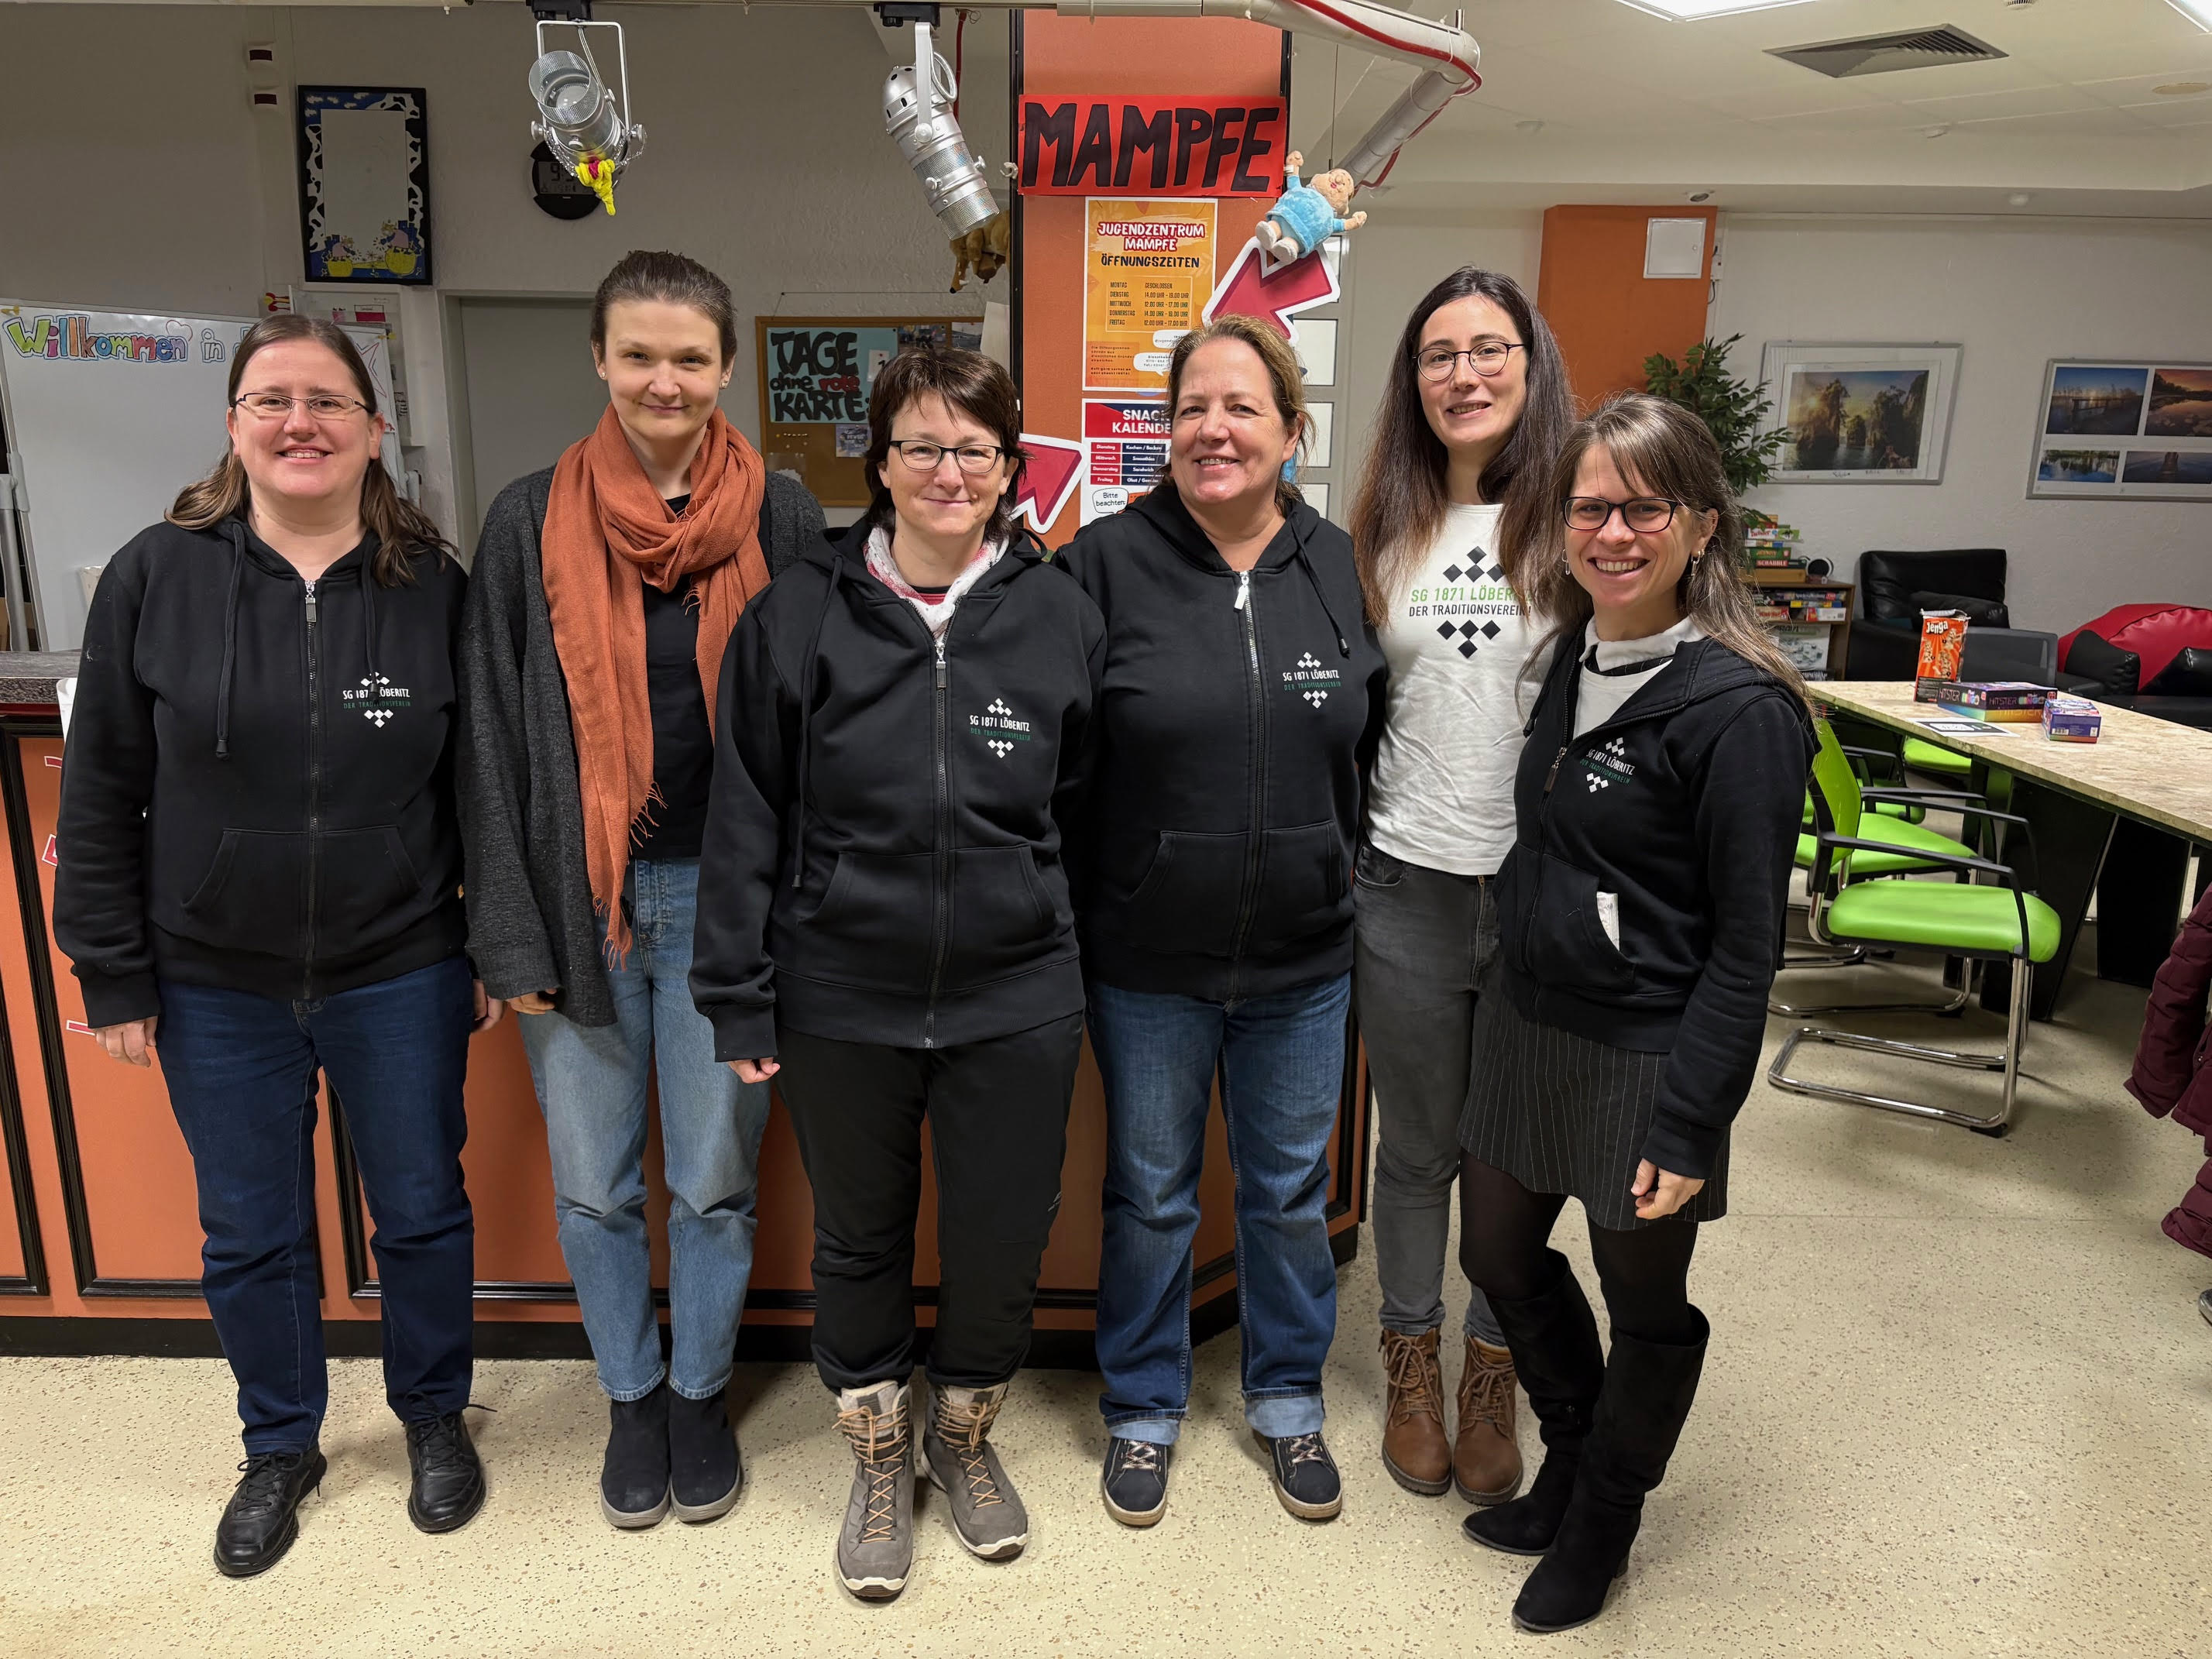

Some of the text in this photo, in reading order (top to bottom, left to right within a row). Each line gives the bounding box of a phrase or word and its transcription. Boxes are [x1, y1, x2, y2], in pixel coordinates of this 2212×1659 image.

[1022, 102, 1279, 192] MAMPFE
[1097, 222, 1205, 237] JUGENDZENTRUM
[1124, 237, 1176, 251] MAMPFE
[1101, 253, 1200, 268] ÖFFNUNGSZEITEN
[6, 316, 187, 361] Willkommen
[203, 329, 224, 362] in
[770, 331, 860, 376] TAGE
[770, 373, 860, 393] ohne rote
[1112, 421, 1171, 434] KALENDE
[1410, 589, 1428, 602] SG
[1434, 587, 1464, 601] 1871
[1409, 606, 1428, 617] DER
[1925, 620, 1948, 634] Jenga
[1282, 668, 1339, 681] SG 1871 LÖBERITZ
[342, 687, 410, 699] SG 187 ÖBERITZ
[969, 715, 1030, 732] SG 1871 LÖBERITZ
[1592, 750, 1607, 764] 1871
[1606, 756, 1635, 775] LÖBERITZ
